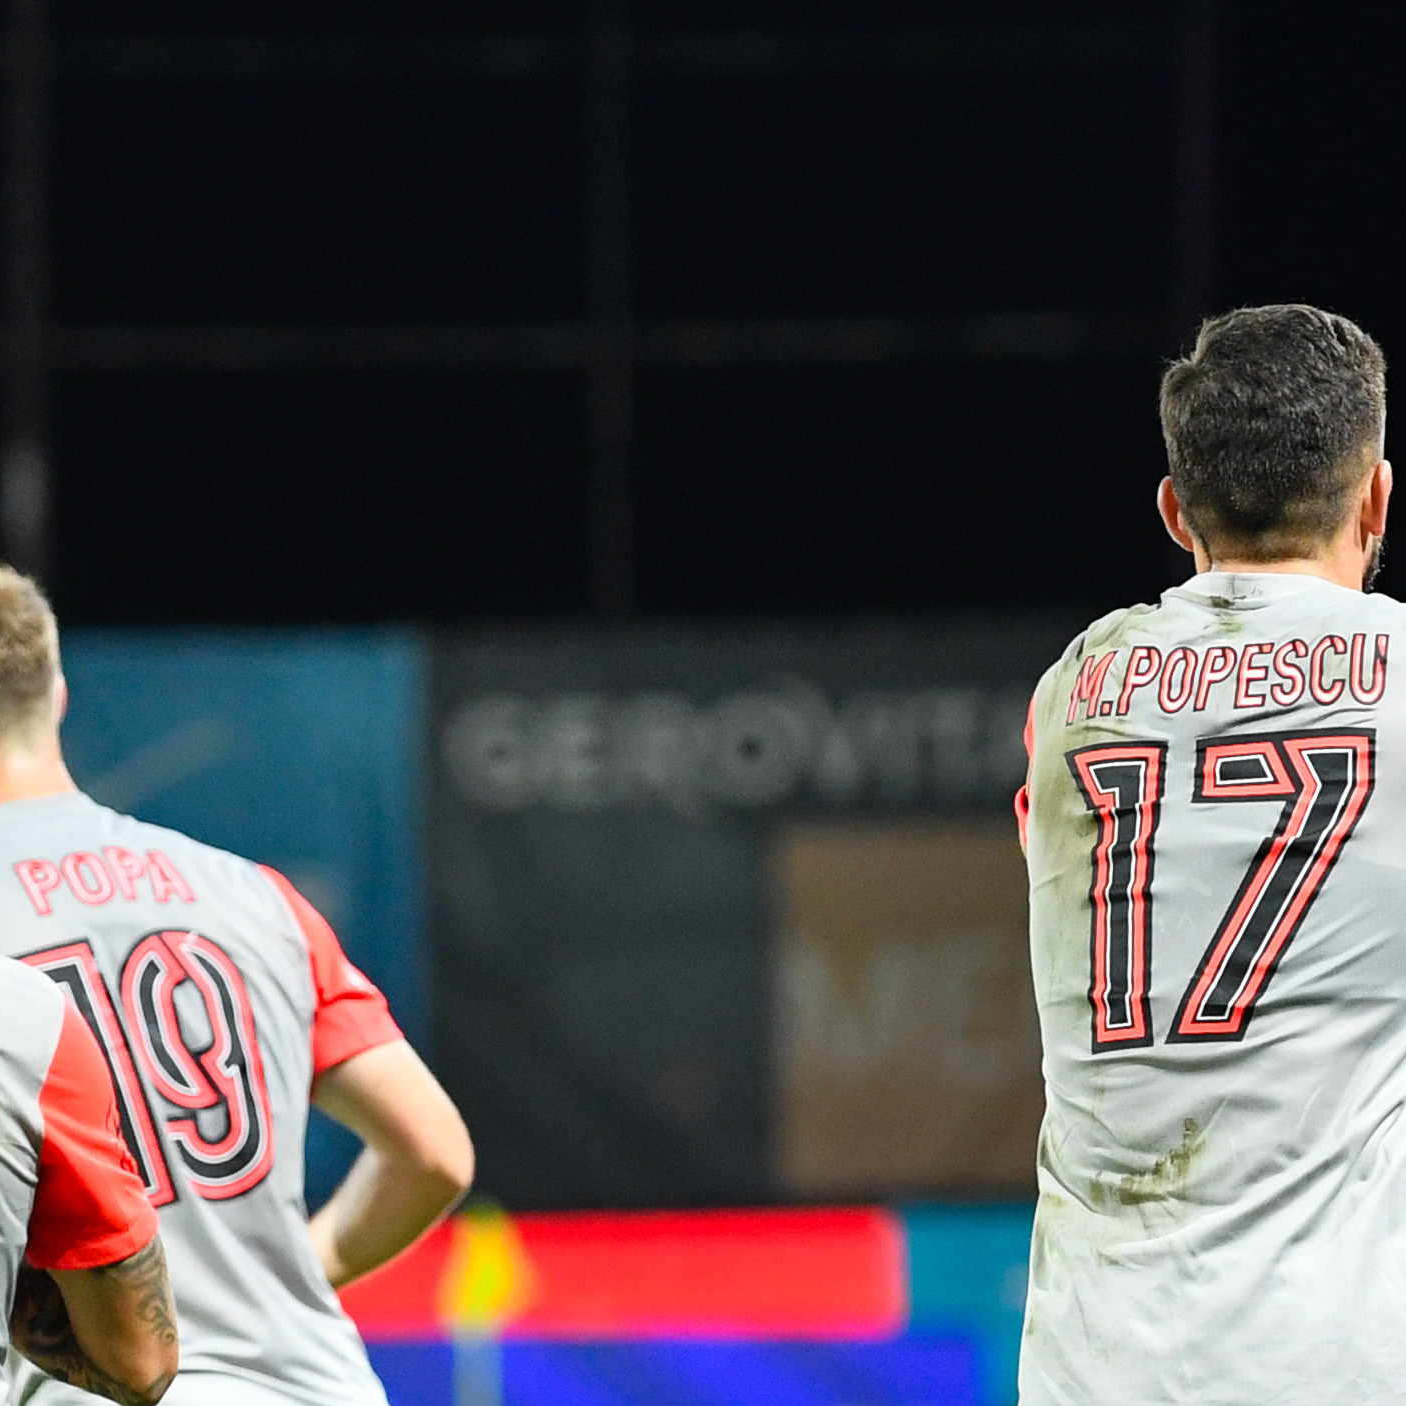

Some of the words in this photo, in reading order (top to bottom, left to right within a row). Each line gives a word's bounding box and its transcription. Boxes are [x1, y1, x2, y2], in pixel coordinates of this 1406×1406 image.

[1066, 633, 1390, 726] M.POPESCU
[15, 847, 196, 916] POPA
[1063, 727, 1377, 1055] 17
[17, 928, 274, 1209] 19
